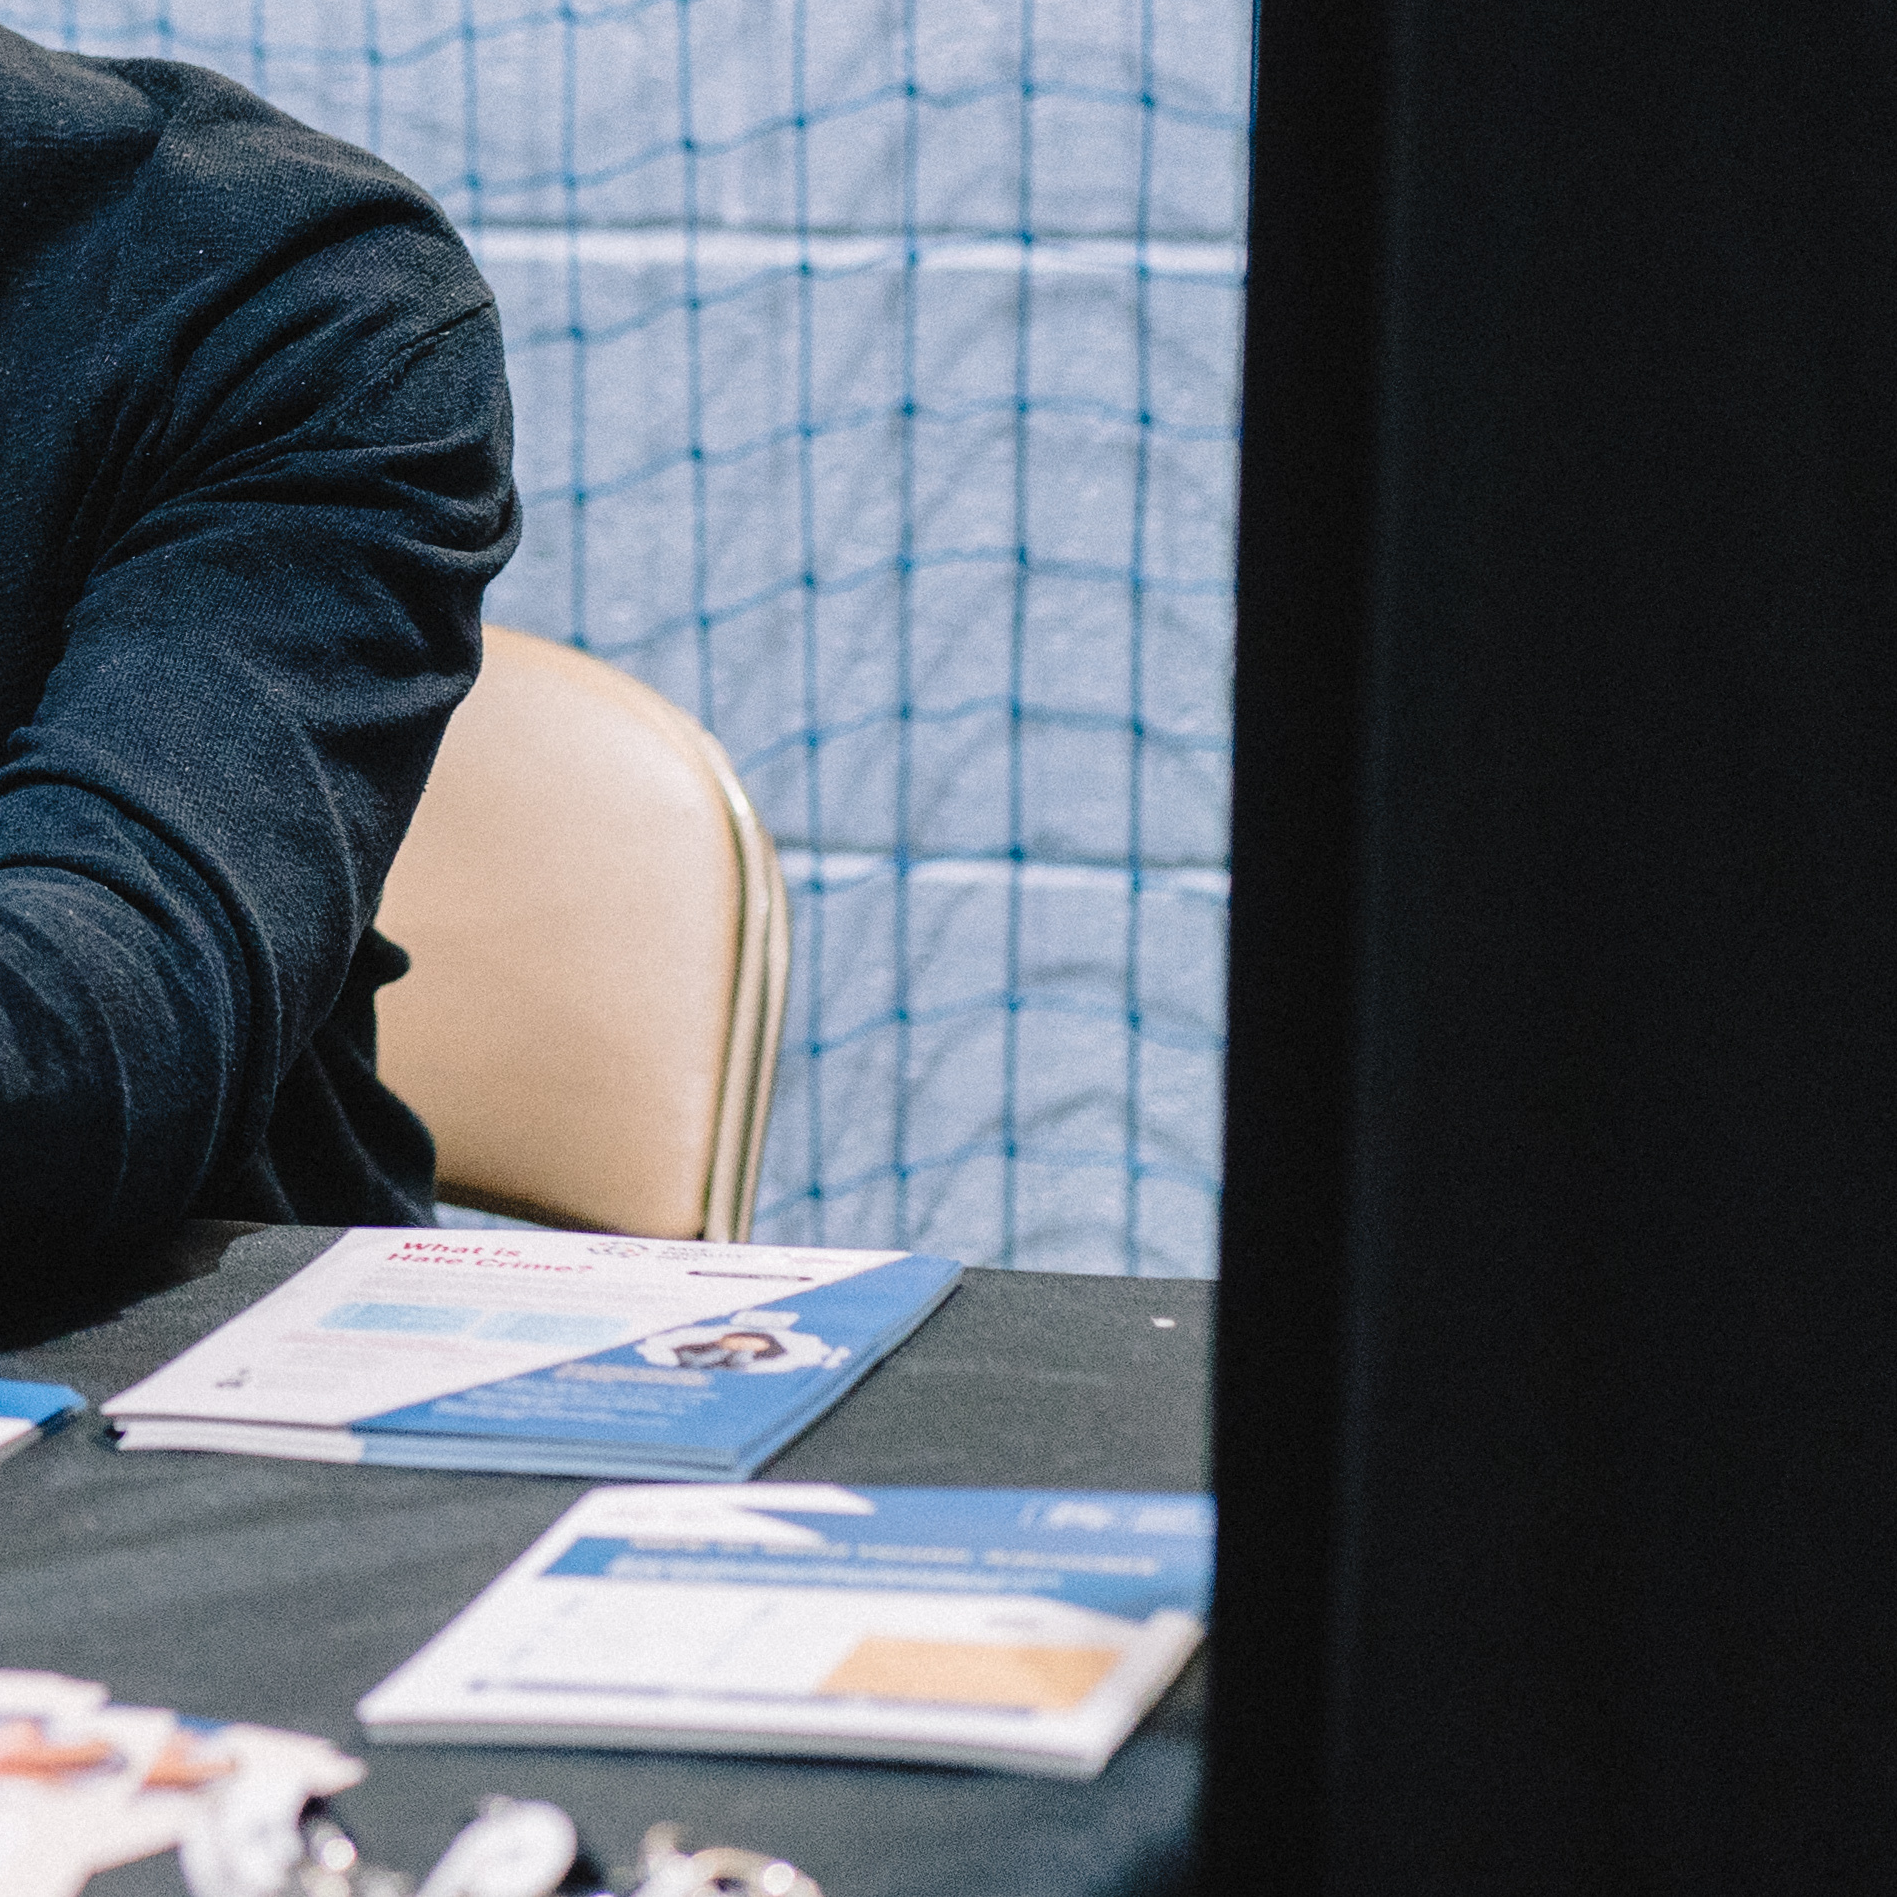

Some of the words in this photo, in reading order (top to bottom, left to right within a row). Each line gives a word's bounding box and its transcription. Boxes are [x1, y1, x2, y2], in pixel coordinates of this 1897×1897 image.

[402, 1242, 484, 1256] What
[493, 1247, 521, 1257] is
[386, 1253, 463, 1264] Hate
[475, 1259, 594, 1274] Crime?
